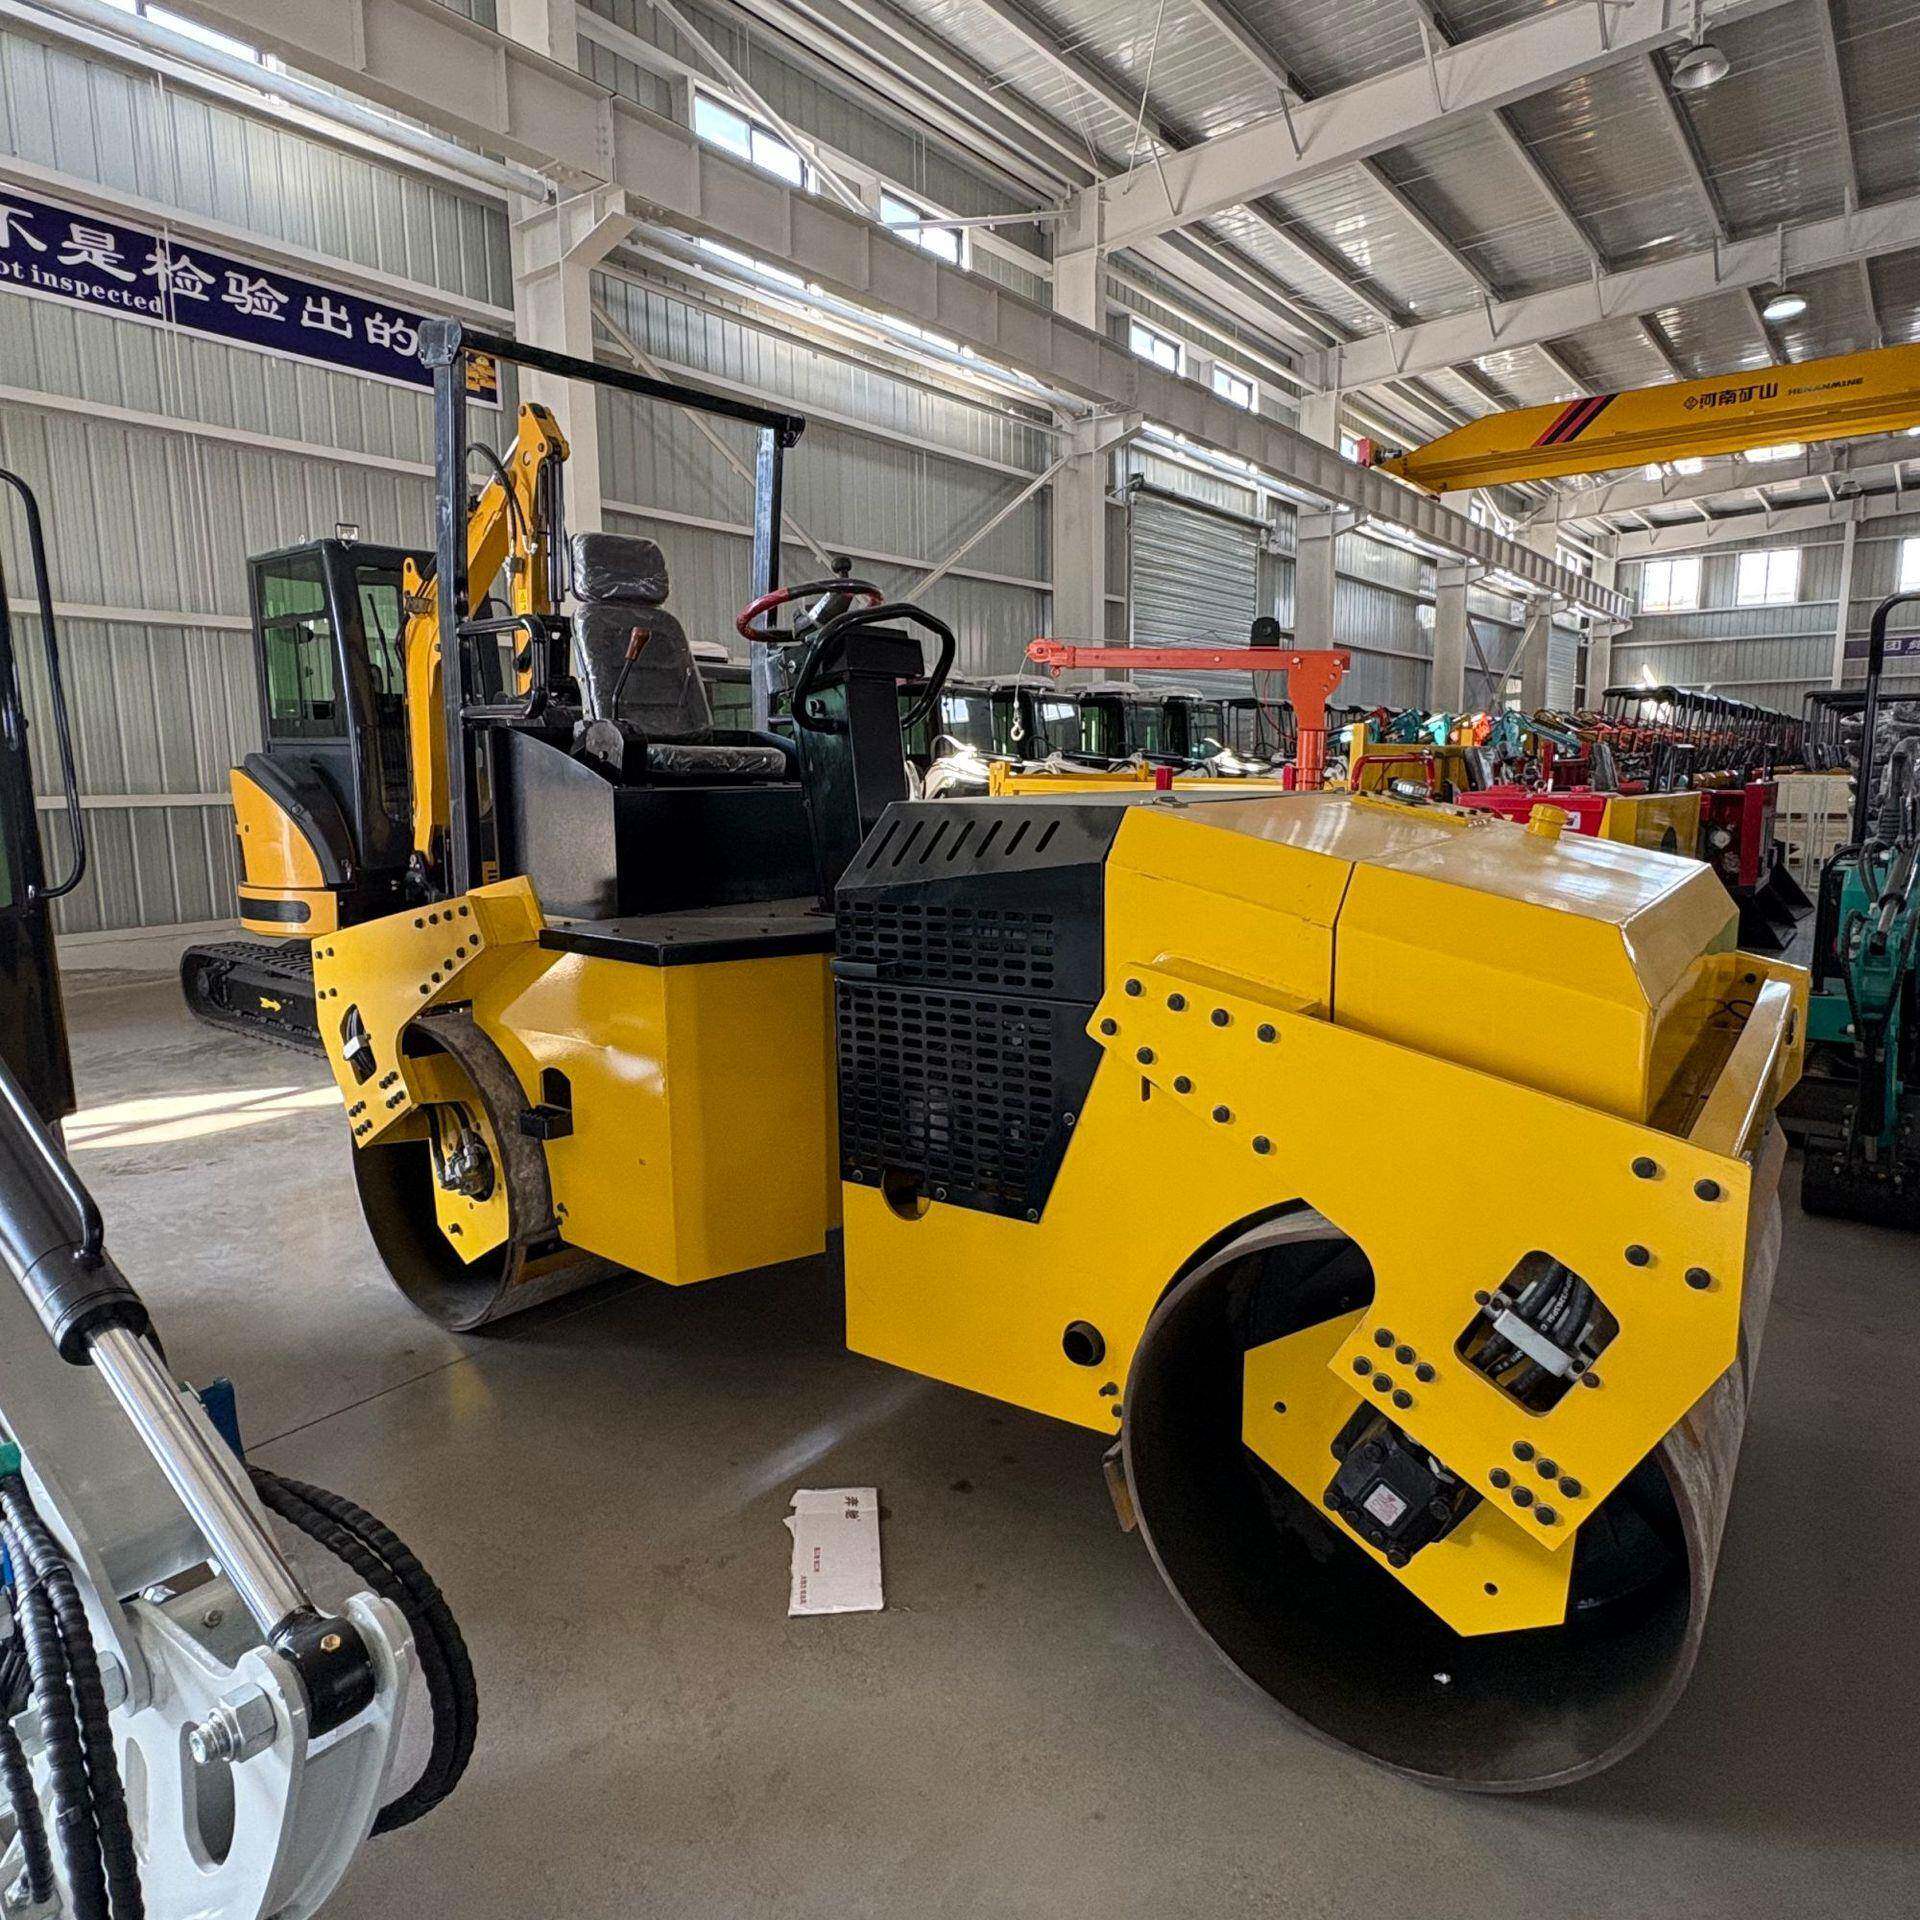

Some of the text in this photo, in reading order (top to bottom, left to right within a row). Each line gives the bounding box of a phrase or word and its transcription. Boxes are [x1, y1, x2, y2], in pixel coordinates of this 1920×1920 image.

[31, 264, 163, 314] inspected
[1699, 383, 1779, 409] 河南矿山
